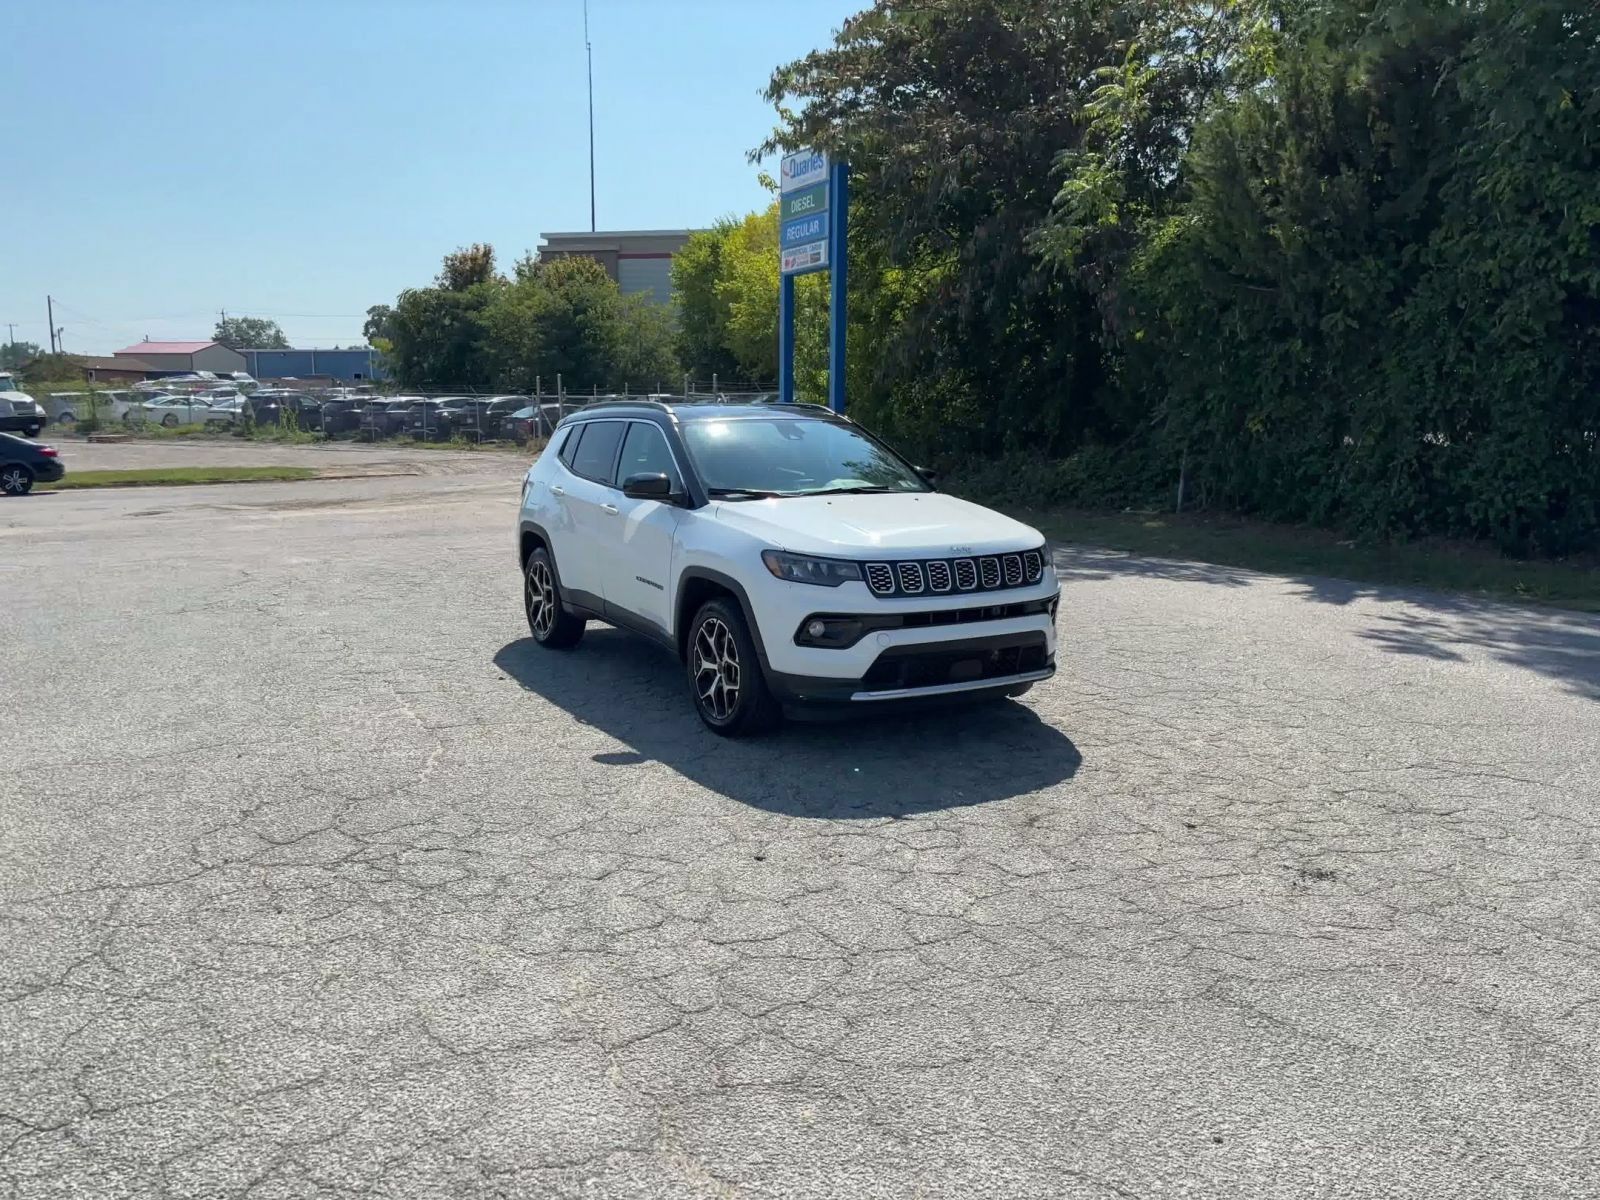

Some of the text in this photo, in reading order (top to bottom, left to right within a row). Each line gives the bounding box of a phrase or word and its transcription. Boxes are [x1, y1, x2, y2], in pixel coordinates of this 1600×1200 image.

[790, 154, 823, 178] Quarles
[791, 195, 815, 213] DIESEL
[786, 220, 819, 240] REGULAR
